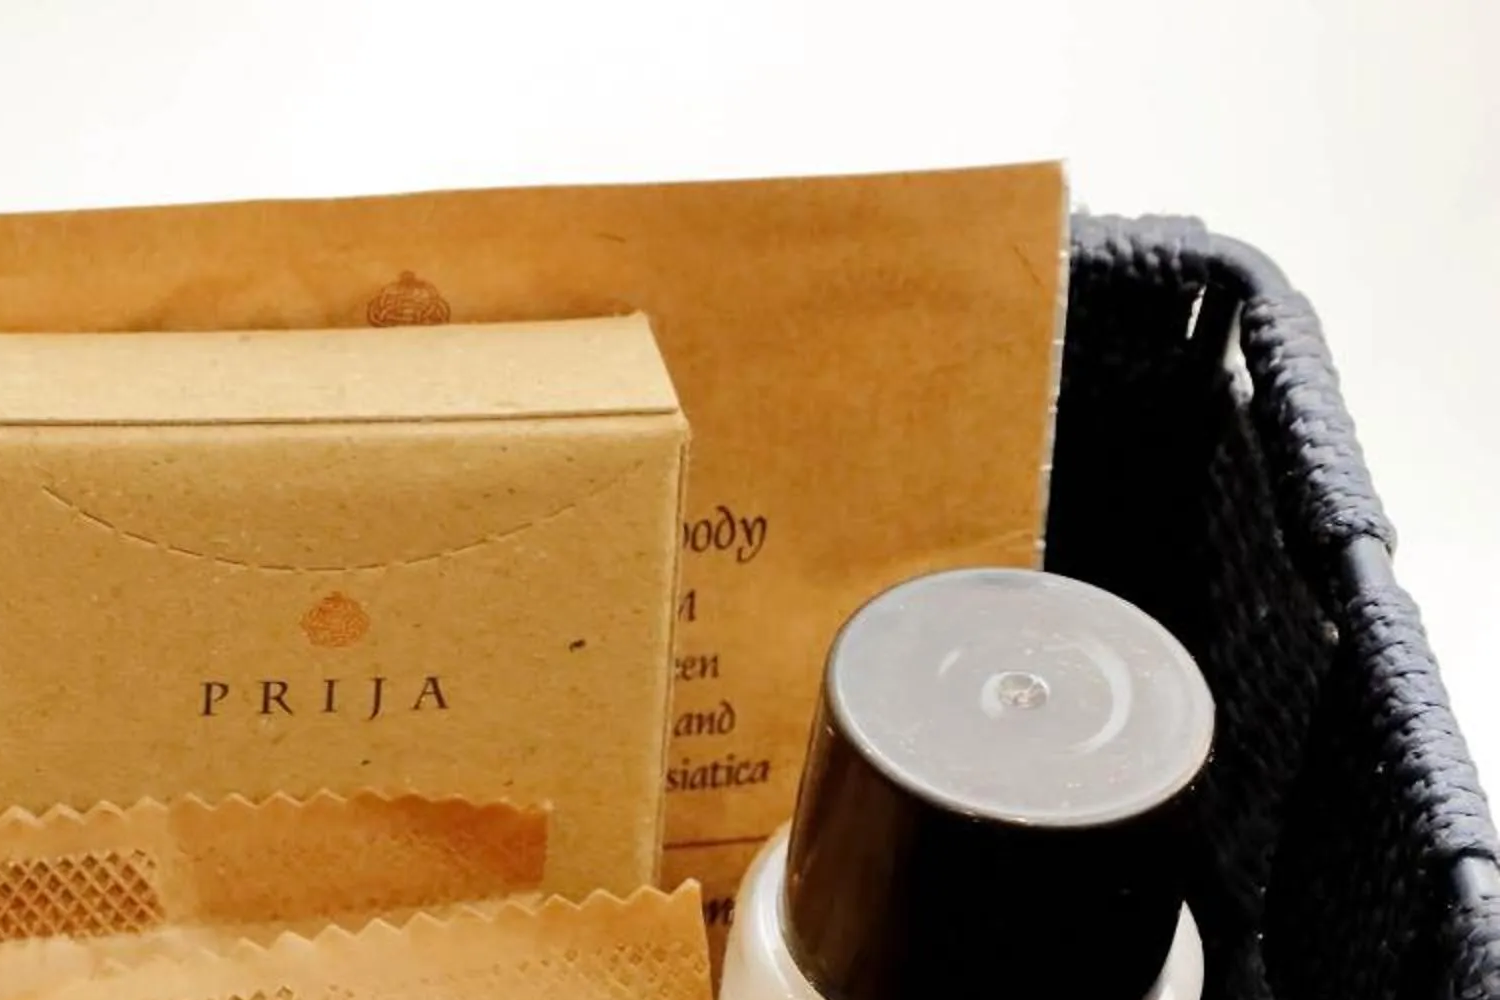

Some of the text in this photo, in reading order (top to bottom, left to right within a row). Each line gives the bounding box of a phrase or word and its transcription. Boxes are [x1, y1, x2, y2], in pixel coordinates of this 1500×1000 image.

[682, 505, 768, 564] ody
[199, 675, 451, 722] PRIJA
[673, 699, 736, 737] and
[664, 752, 770, 792] siatica
